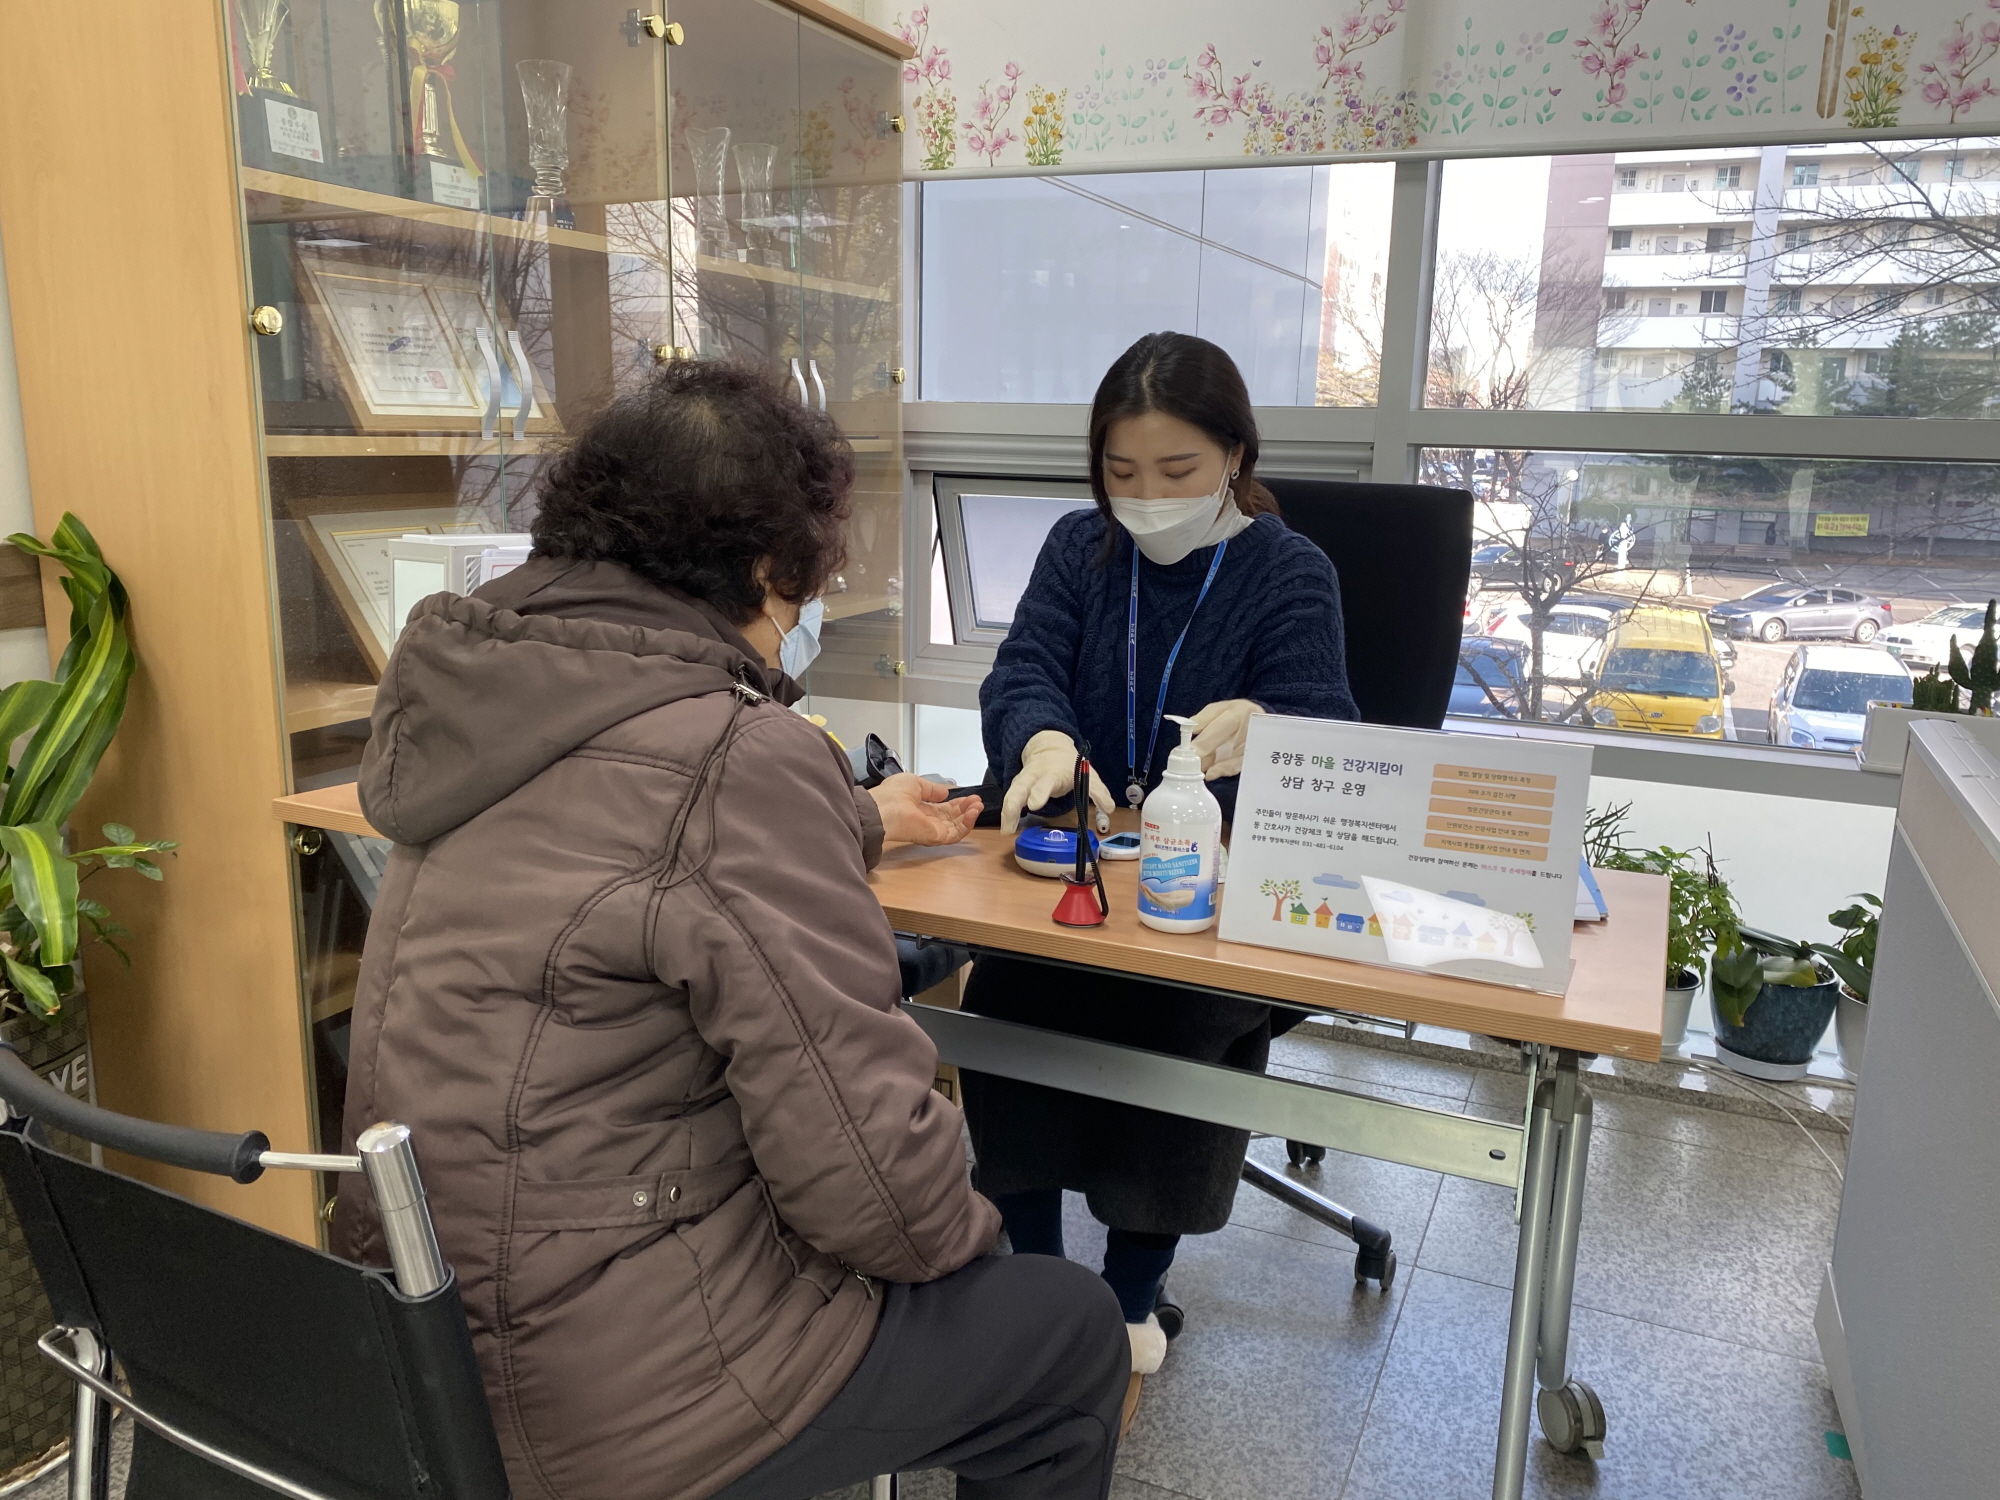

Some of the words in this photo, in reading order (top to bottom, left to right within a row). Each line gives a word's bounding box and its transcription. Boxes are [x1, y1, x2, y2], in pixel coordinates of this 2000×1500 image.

[1270, 751, 1305, 767] 중앙동
[1311, 755, 1336, 770] 마을
[1342, 758, 1403, 776] 건강지킴이
[1280, 775, 1305, 790] 상담
[1311, 778, 1335, 793] 창구
[1341, 782, 1366, 797] 운영
[1255, 808, 1282, 819] 주민들이
[1285, 812, 1319, 823] 방문하시기
[1322, 816, 1336, 825] 쉬운
[1340, 818, 1397, 832] 행정복지센터에서
[1253, 821, 1260, 830] 동
[1263, 822, 1291, 833] 간호사가
[1294, 826, 1322, 837] 건강체크
[1326, 830, 1333, 838] 및
[1336, 831, 1358, 842] 상담을
[1361, 834, 1399, 847] 해드립니다.
[1269, 836, 1300, 846] 행정복지센터
[1540, 871, 1562, 880] 드립니다
